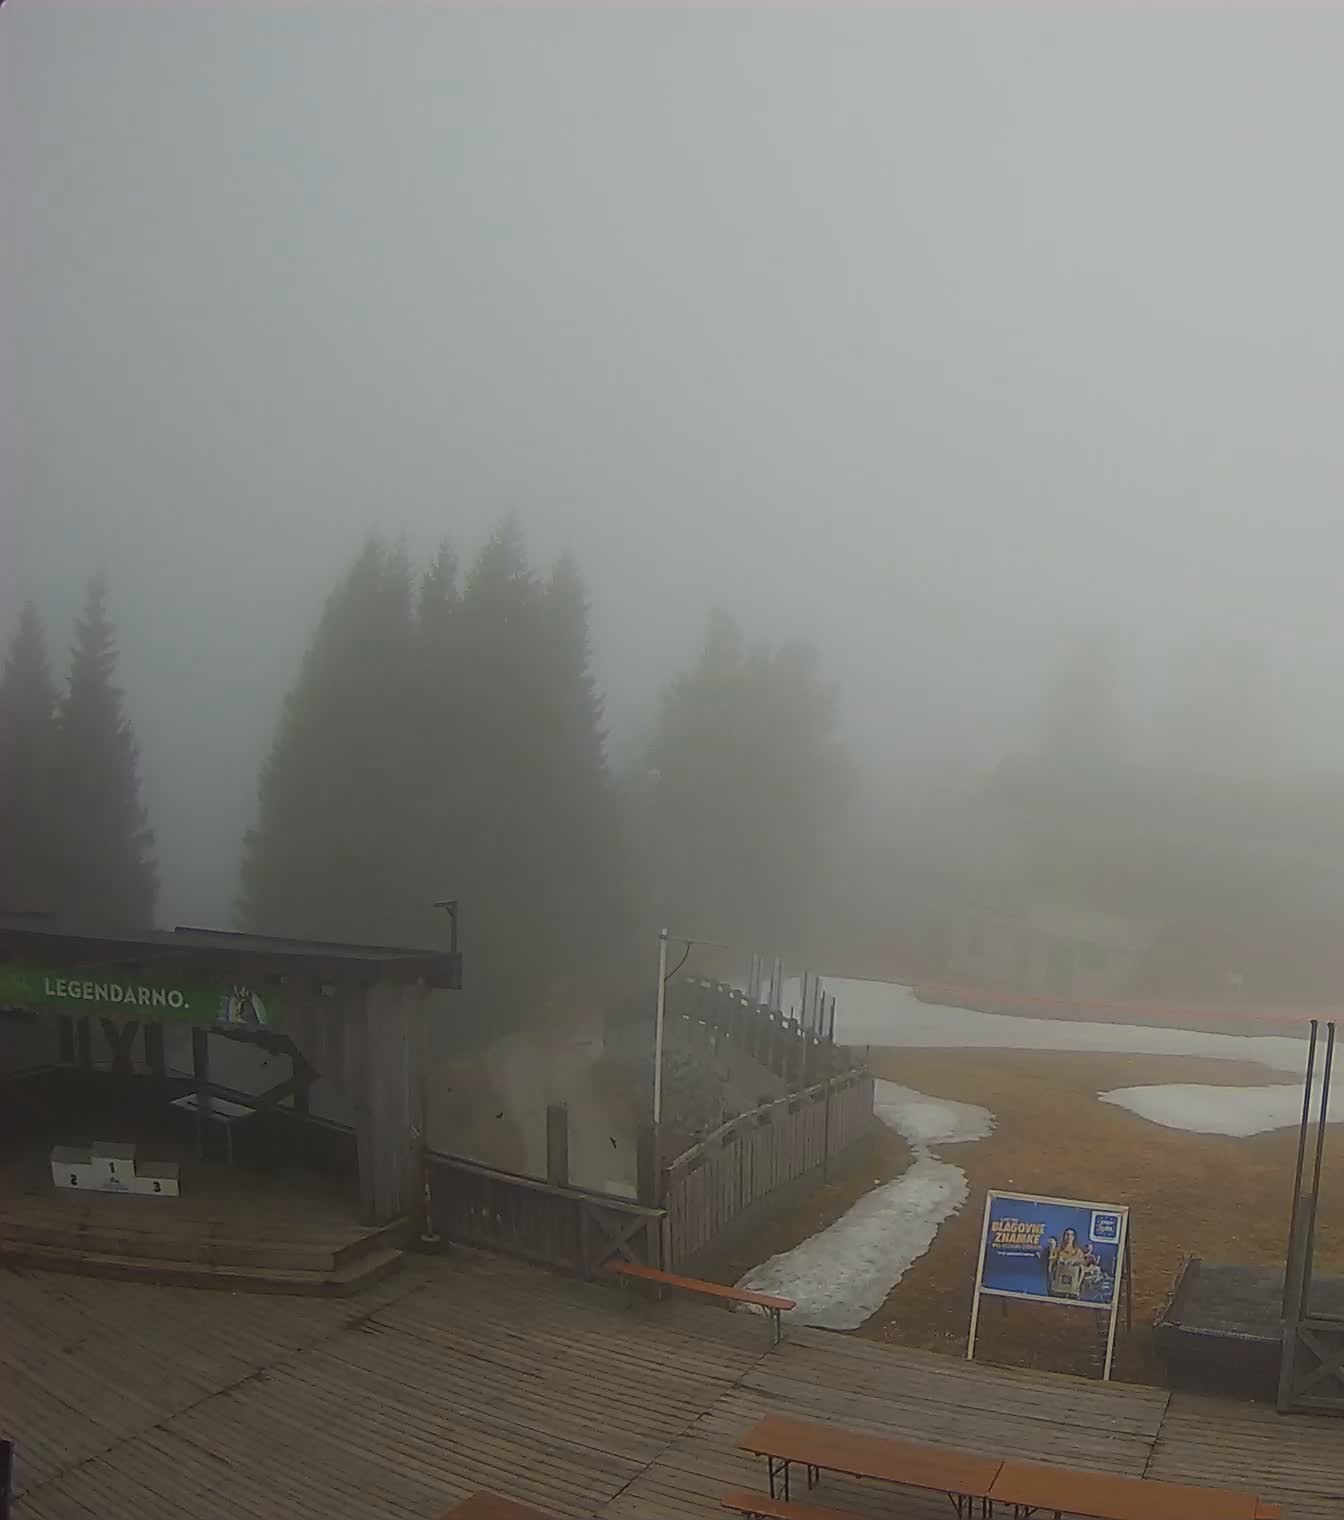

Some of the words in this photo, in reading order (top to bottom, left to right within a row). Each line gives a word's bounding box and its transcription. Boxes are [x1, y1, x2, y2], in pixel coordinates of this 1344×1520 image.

[44, 977, 190, 1009] LEGENDARNO.
[109, 1162, 116, 1173] 1
[70, 1174, 78, 1186] 2
[152, 1181, 161, 1192] 3
[992, 1221, 1046, 1234] BLAGOVNE
[994, 1232, 1041, 1245] ZNAMKE
